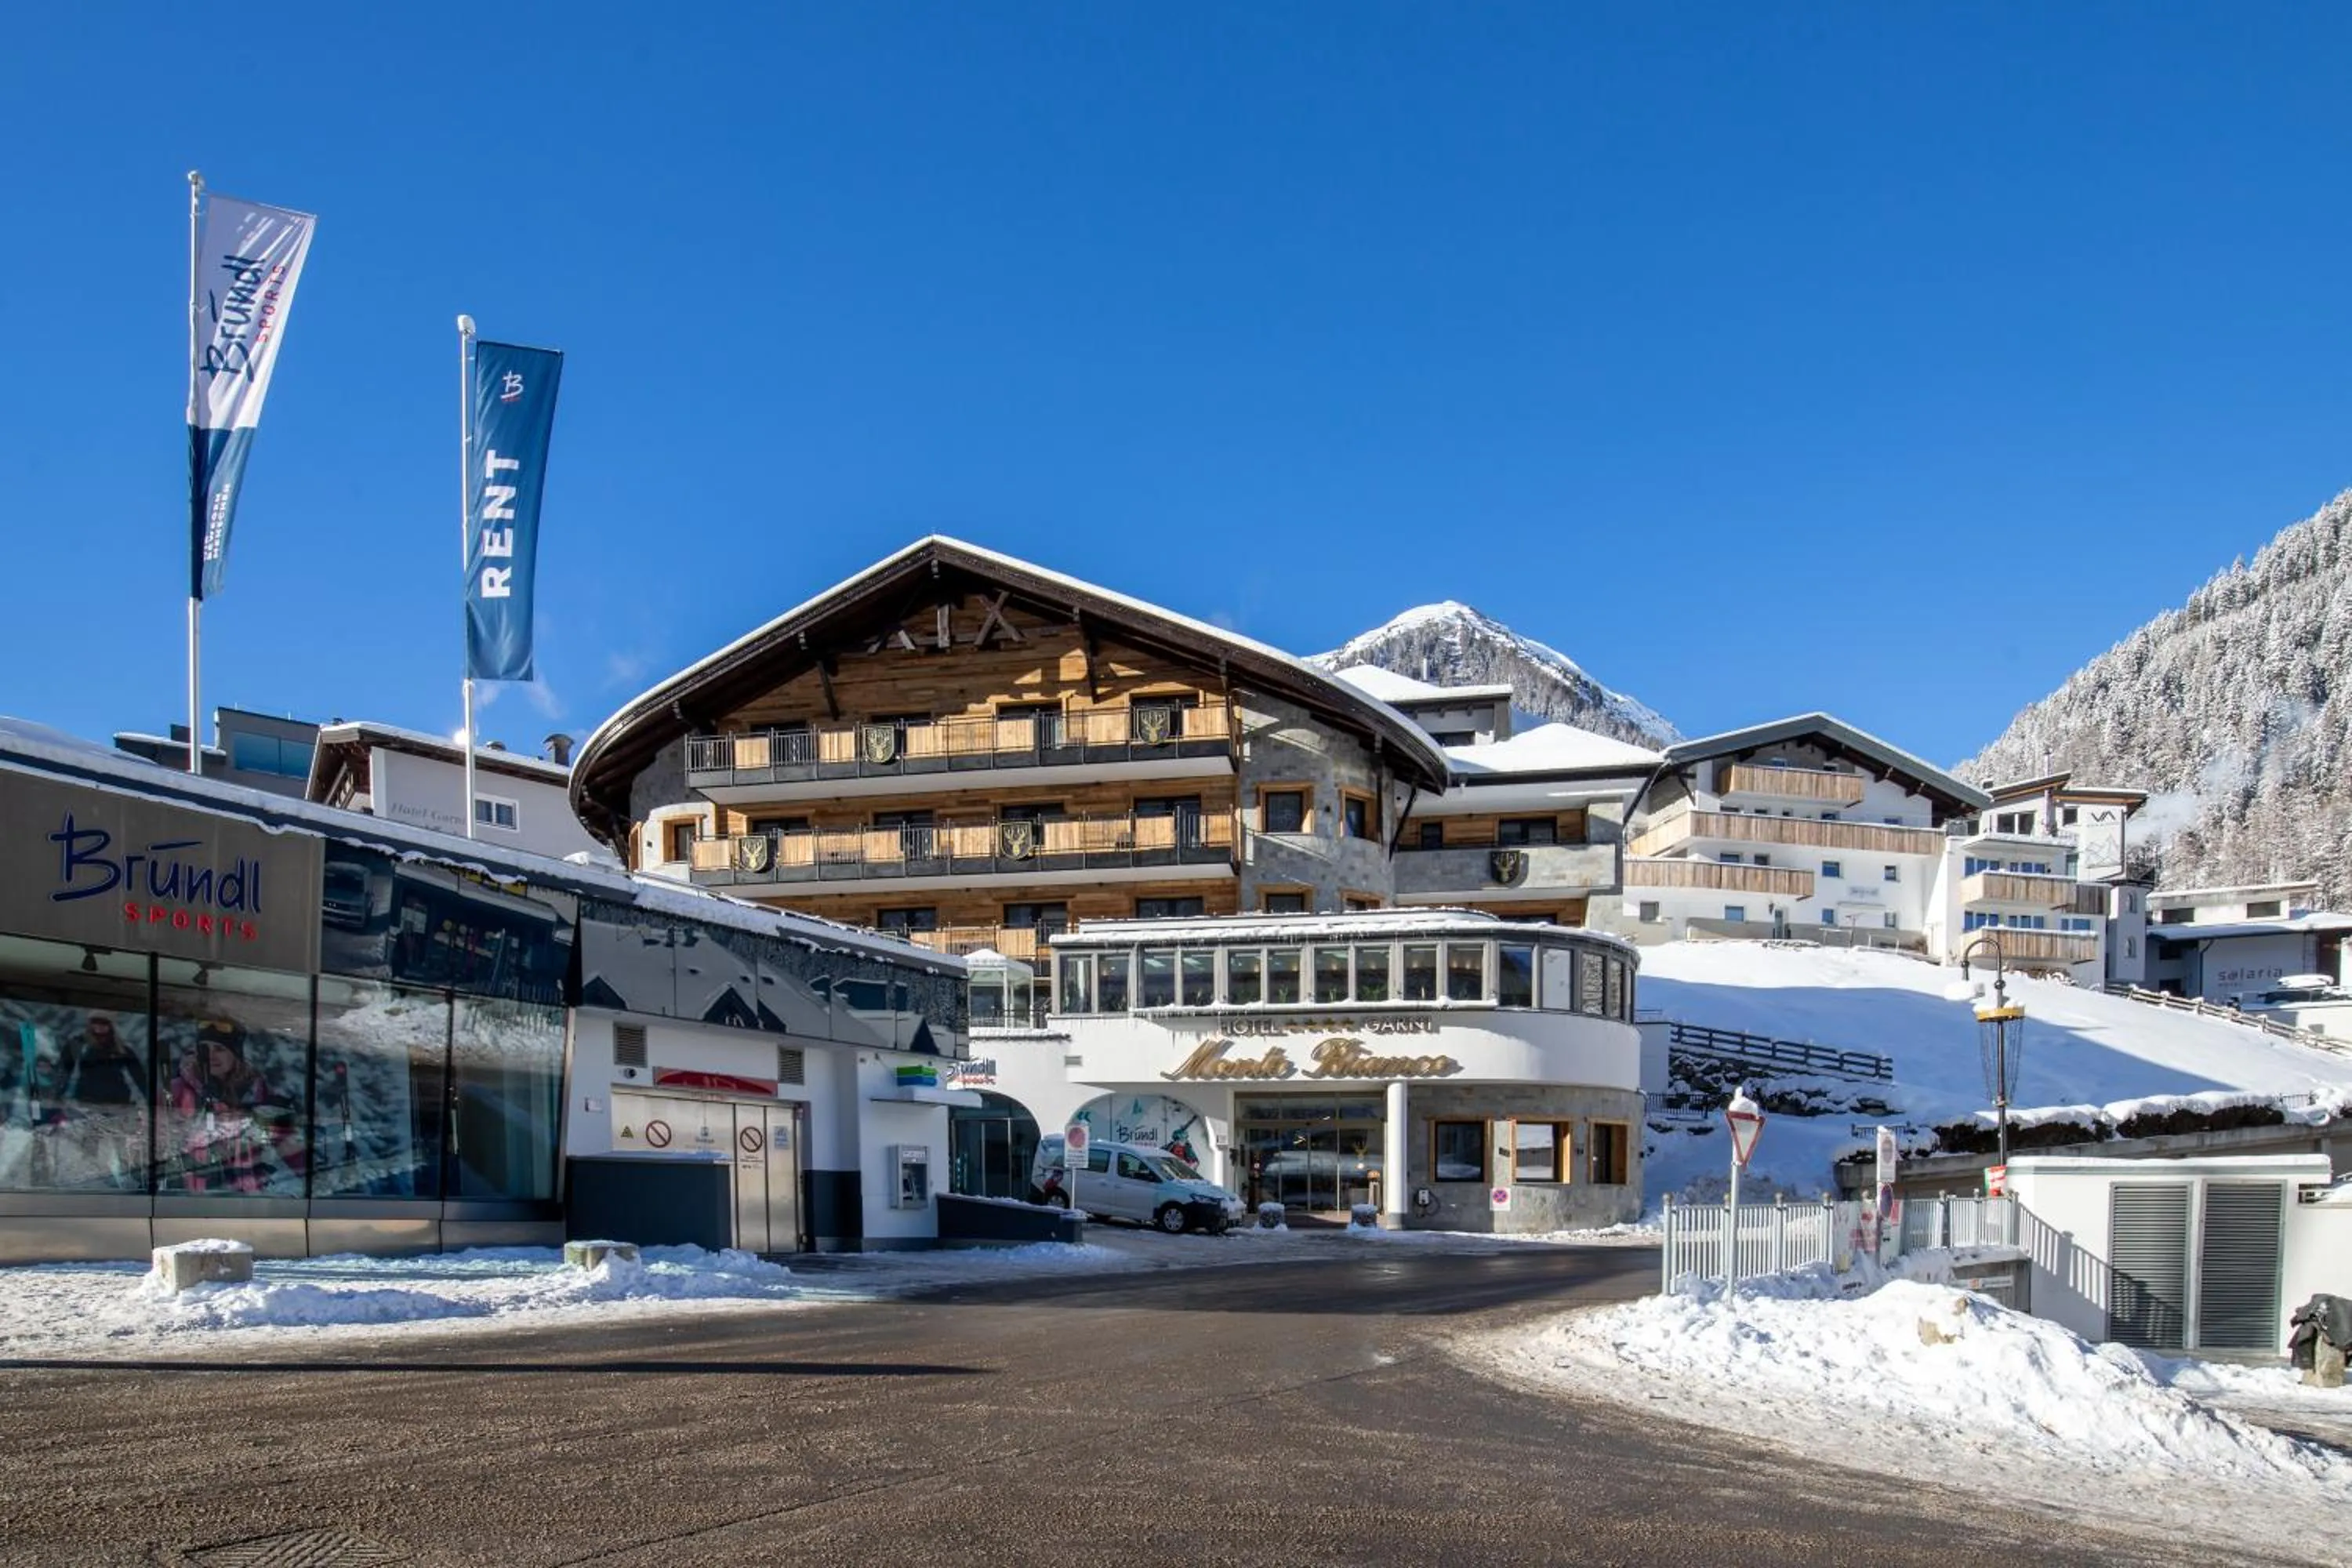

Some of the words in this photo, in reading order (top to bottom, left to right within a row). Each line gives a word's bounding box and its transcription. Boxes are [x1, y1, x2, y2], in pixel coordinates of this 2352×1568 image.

[256, 265, 285, 343] SPORTS
[481, 449, 520, 597] RENT
[124, 902, 259, 941] SPORTS
[1365, 1018, 1432, 1032] GARNI
